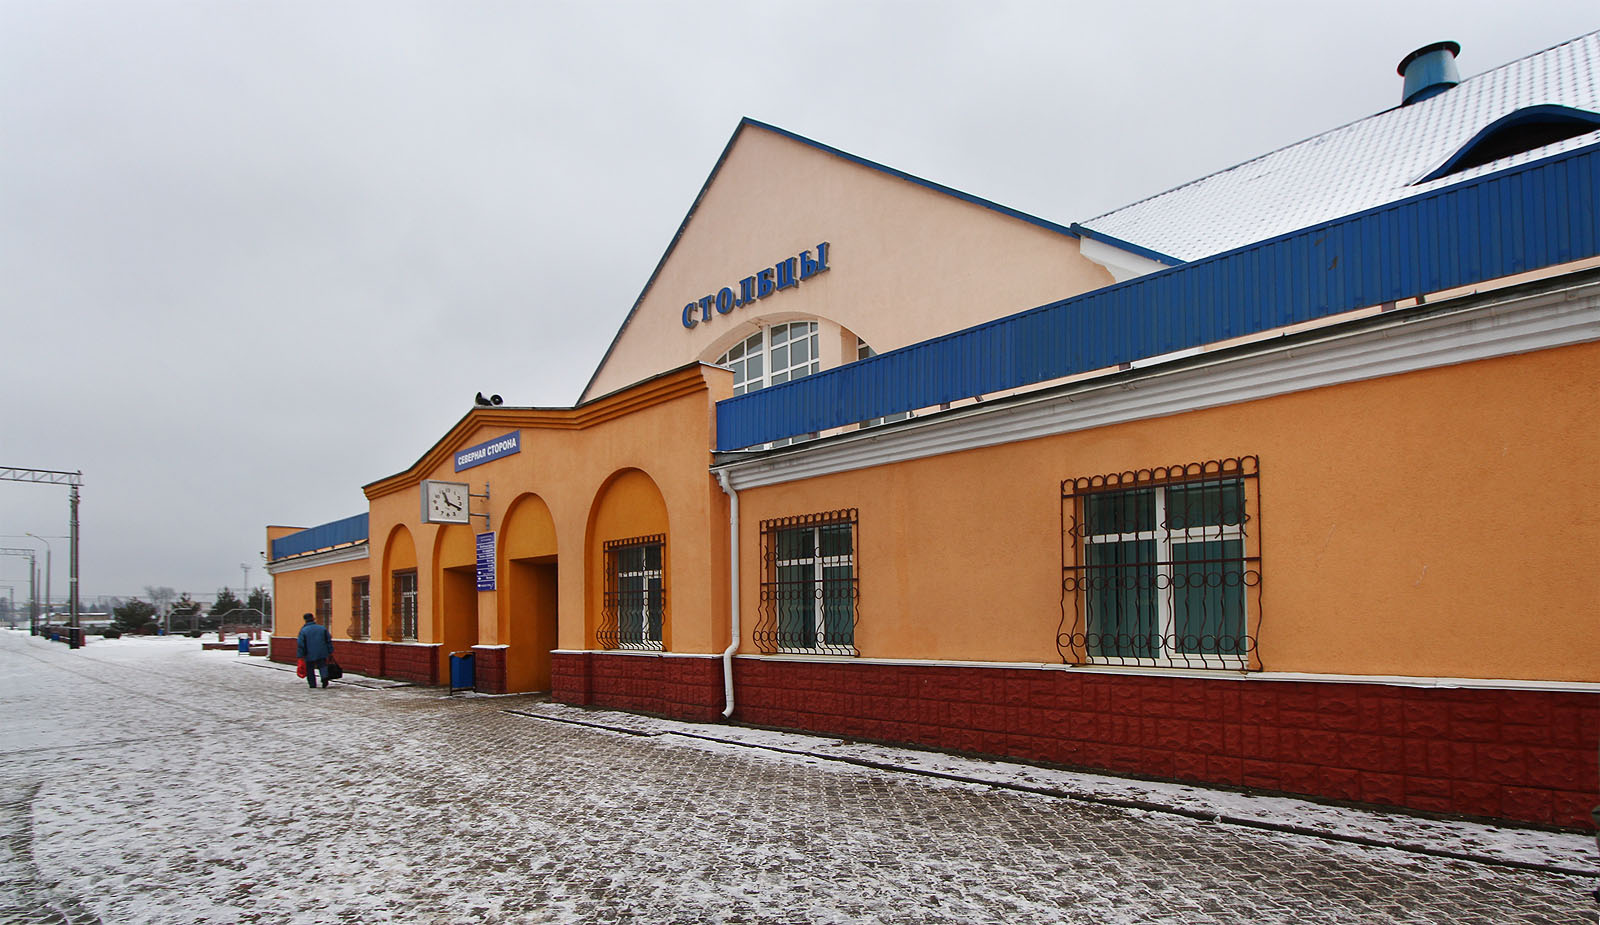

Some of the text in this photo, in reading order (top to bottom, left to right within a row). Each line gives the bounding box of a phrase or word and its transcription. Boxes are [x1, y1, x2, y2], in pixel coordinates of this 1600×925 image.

[682, 240, 831, 329] СТОЛБЦЫ
[457, 437, 517, 466] СЕВЕРНАЯ СТОРОНА
